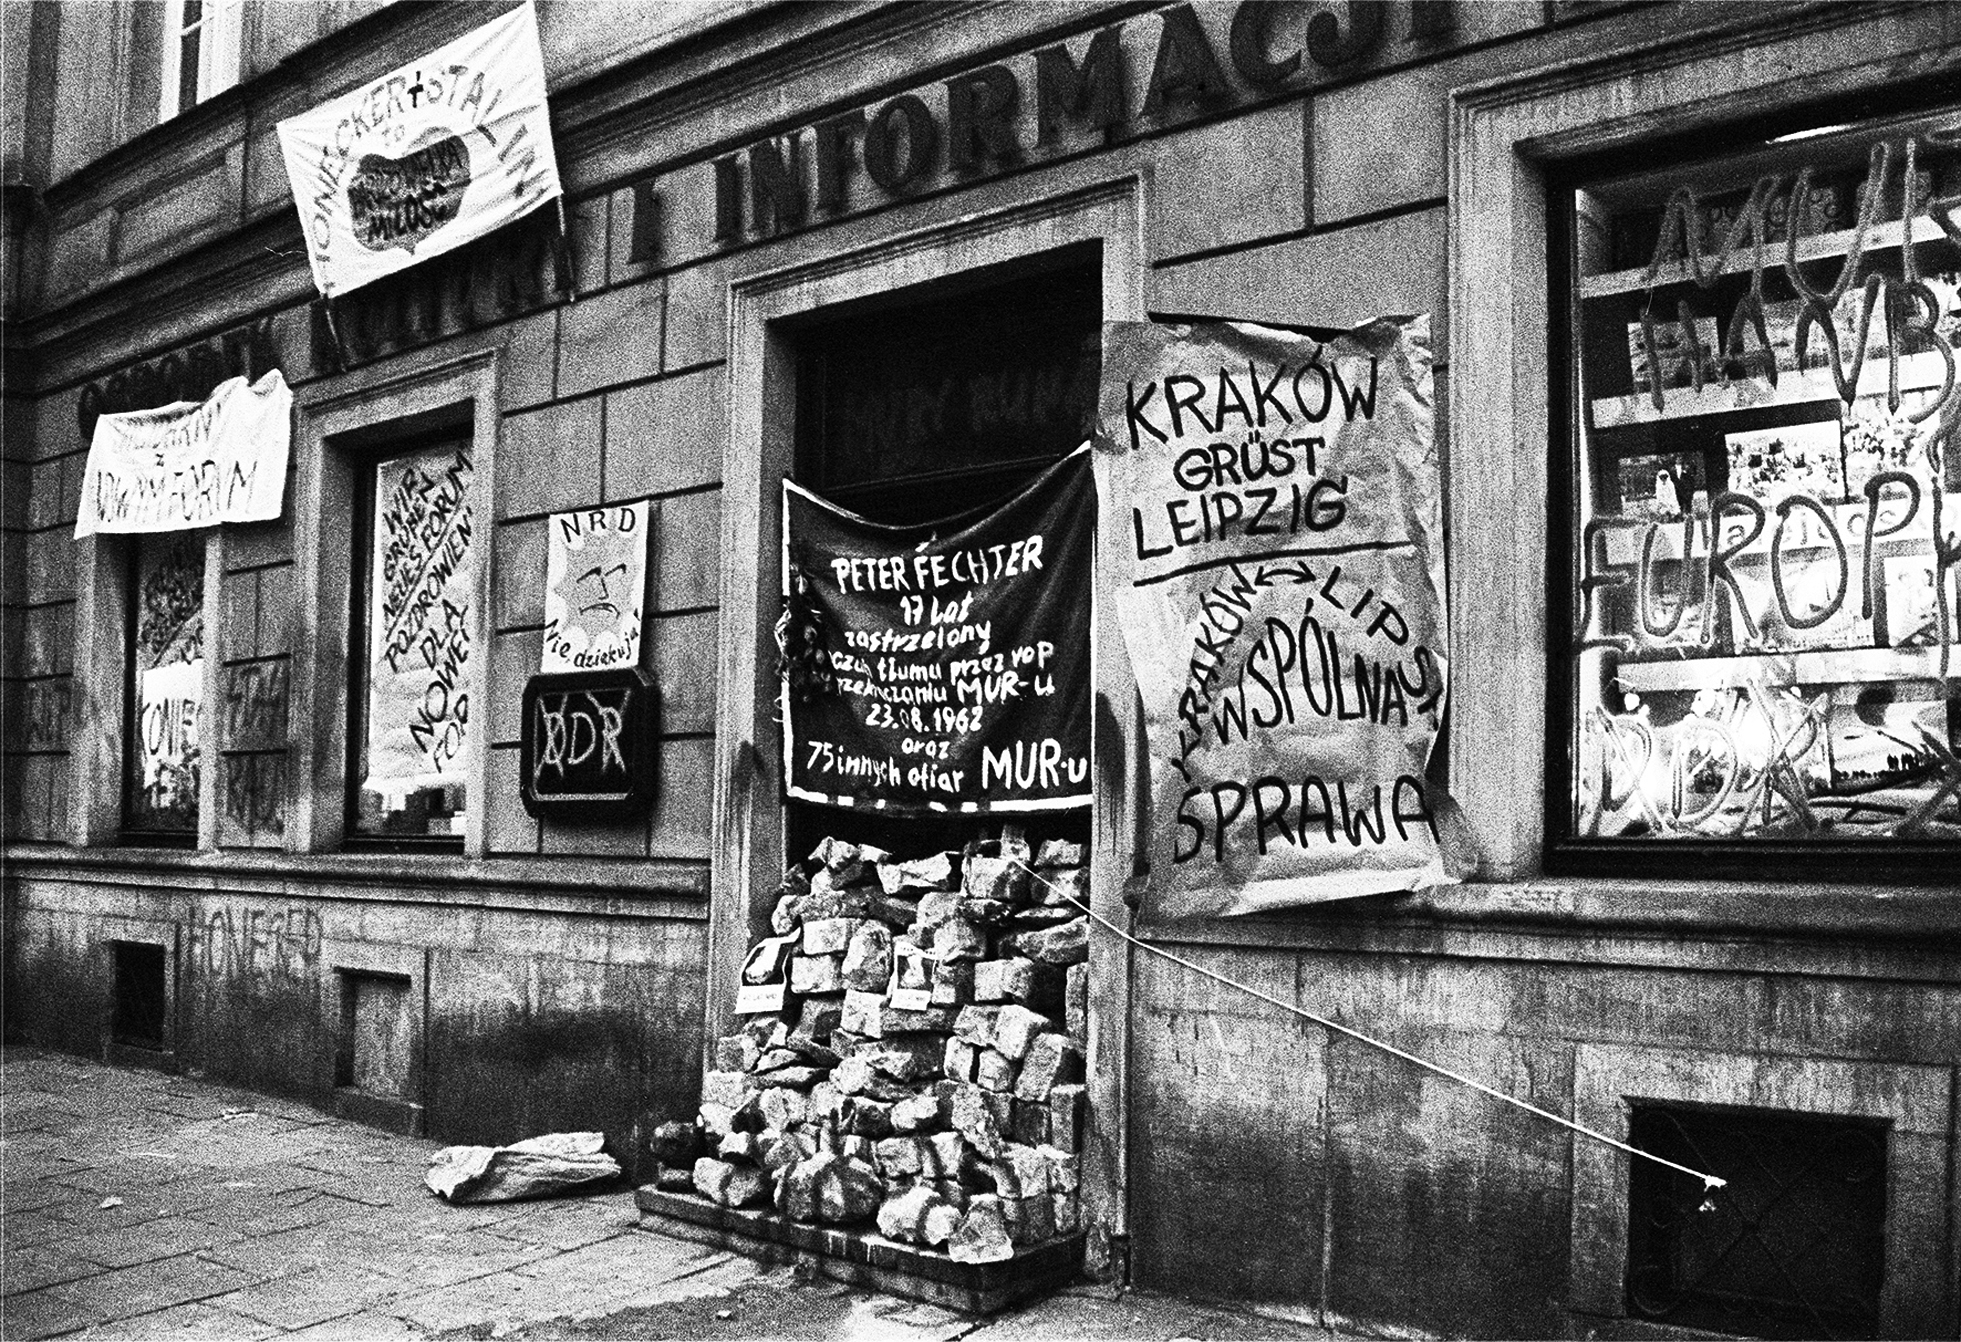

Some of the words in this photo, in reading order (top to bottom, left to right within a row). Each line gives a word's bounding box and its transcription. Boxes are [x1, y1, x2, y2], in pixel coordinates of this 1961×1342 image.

[1126, 344, 1378, 450] KRAKÓW
[1173, 429, 1326, 492] GRÜST
[383, 468, 419, 535] WIR
[420, 449, 474, 553] FORUM
[560, 507, 637, 544] NRD
[1133, 475, 1349, 561] LEIPZIG
[830, 556, 911, 595] PETER
[913, 535, 1044, 590] FECHTER
[420, 599, 461, 671] DLA
[844, 620, 991, 656] zastrzelony
[900, 595, 924, 626] 17
[1213, 598, 1409, 745] WSPÓLNA
[865, 702, 984, 735] 23.08.1962
[901, 737, 951, 760] oraz
[807, 739, 835, 773] 75
[836, 745, 901, 788] innych
[906, 763, 965, 793] ofiar
[1174, 775, 1440, 863] SPRAWA
